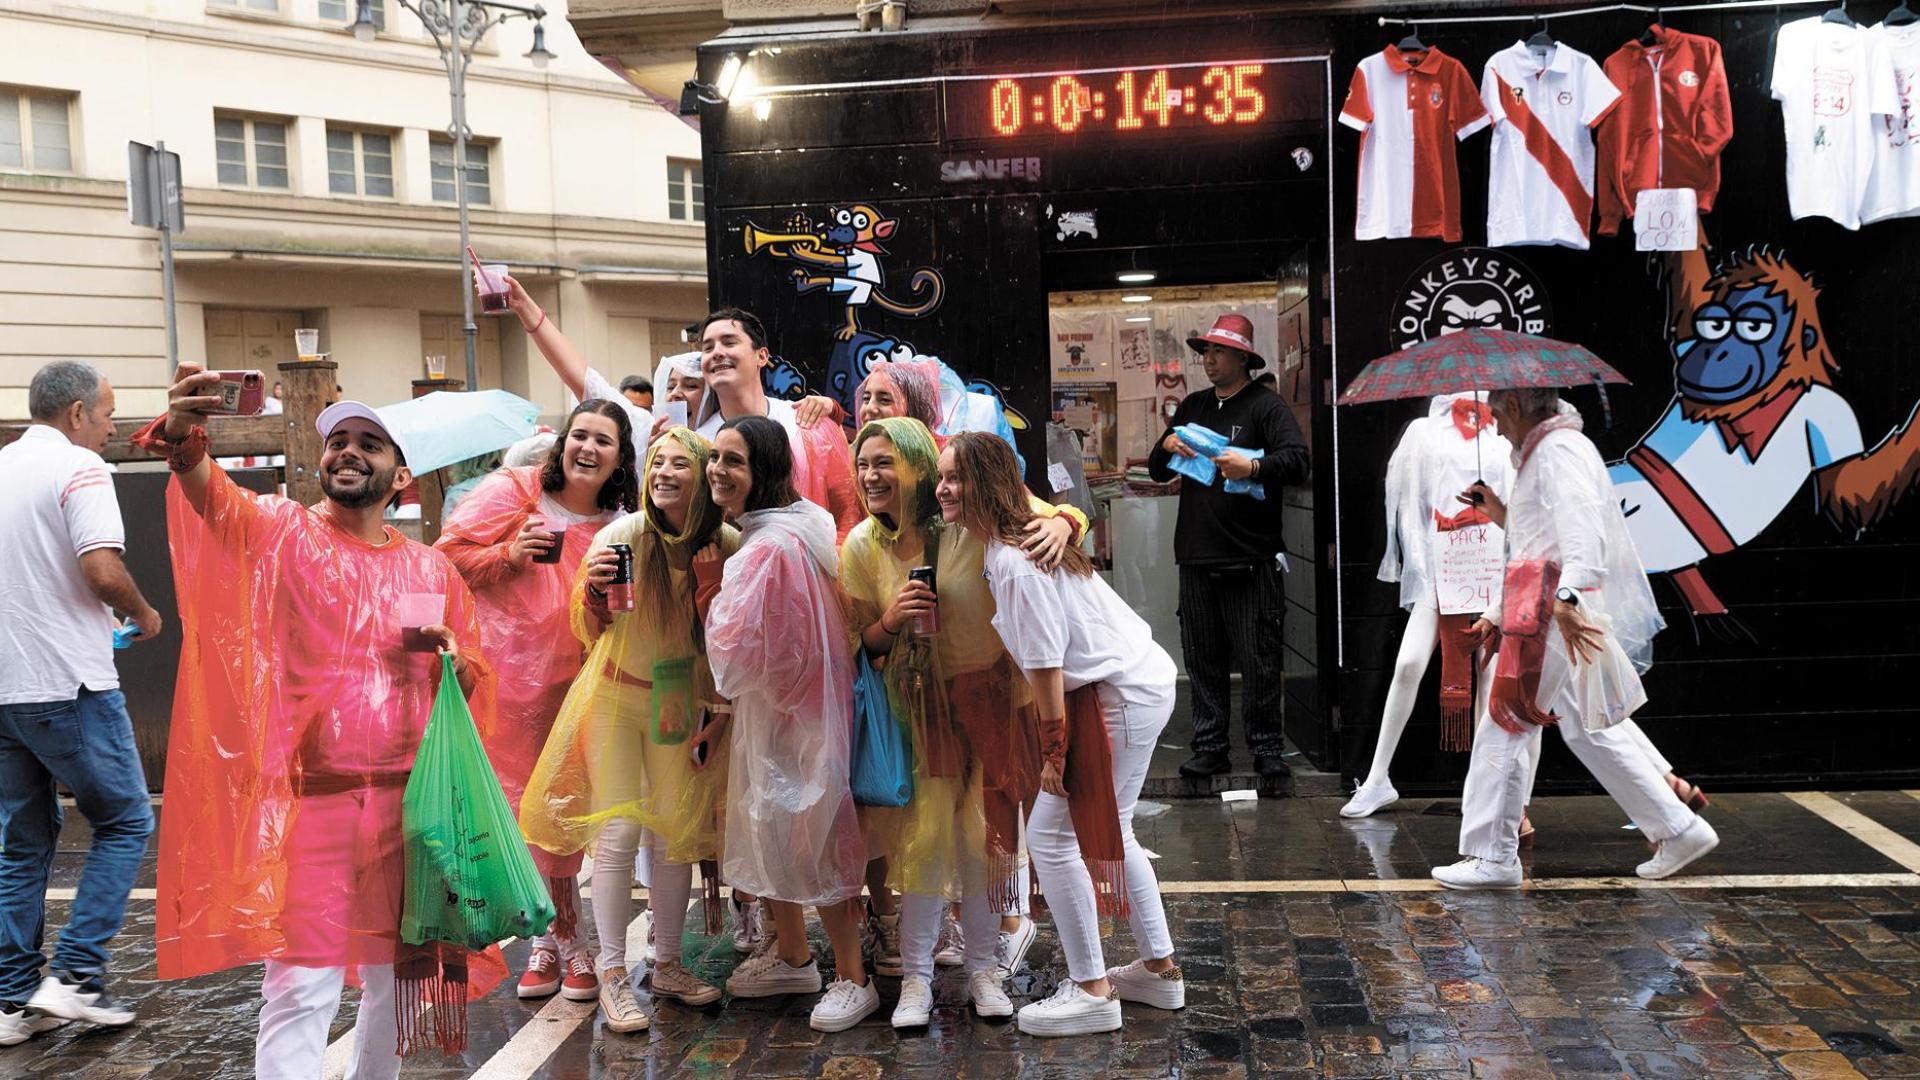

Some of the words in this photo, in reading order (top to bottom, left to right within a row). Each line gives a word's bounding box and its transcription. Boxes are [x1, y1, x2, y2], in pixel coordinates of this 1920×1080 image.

[991, 63, 1265, 135] 0:0:14:35
[940, 157, 1041, 182] SANFER
[1400, 257, 1545, 350] ONKEYSTRIB
[1448, 528, 1487, 546] PACK
[1458, 585, 1490, 609] 24
